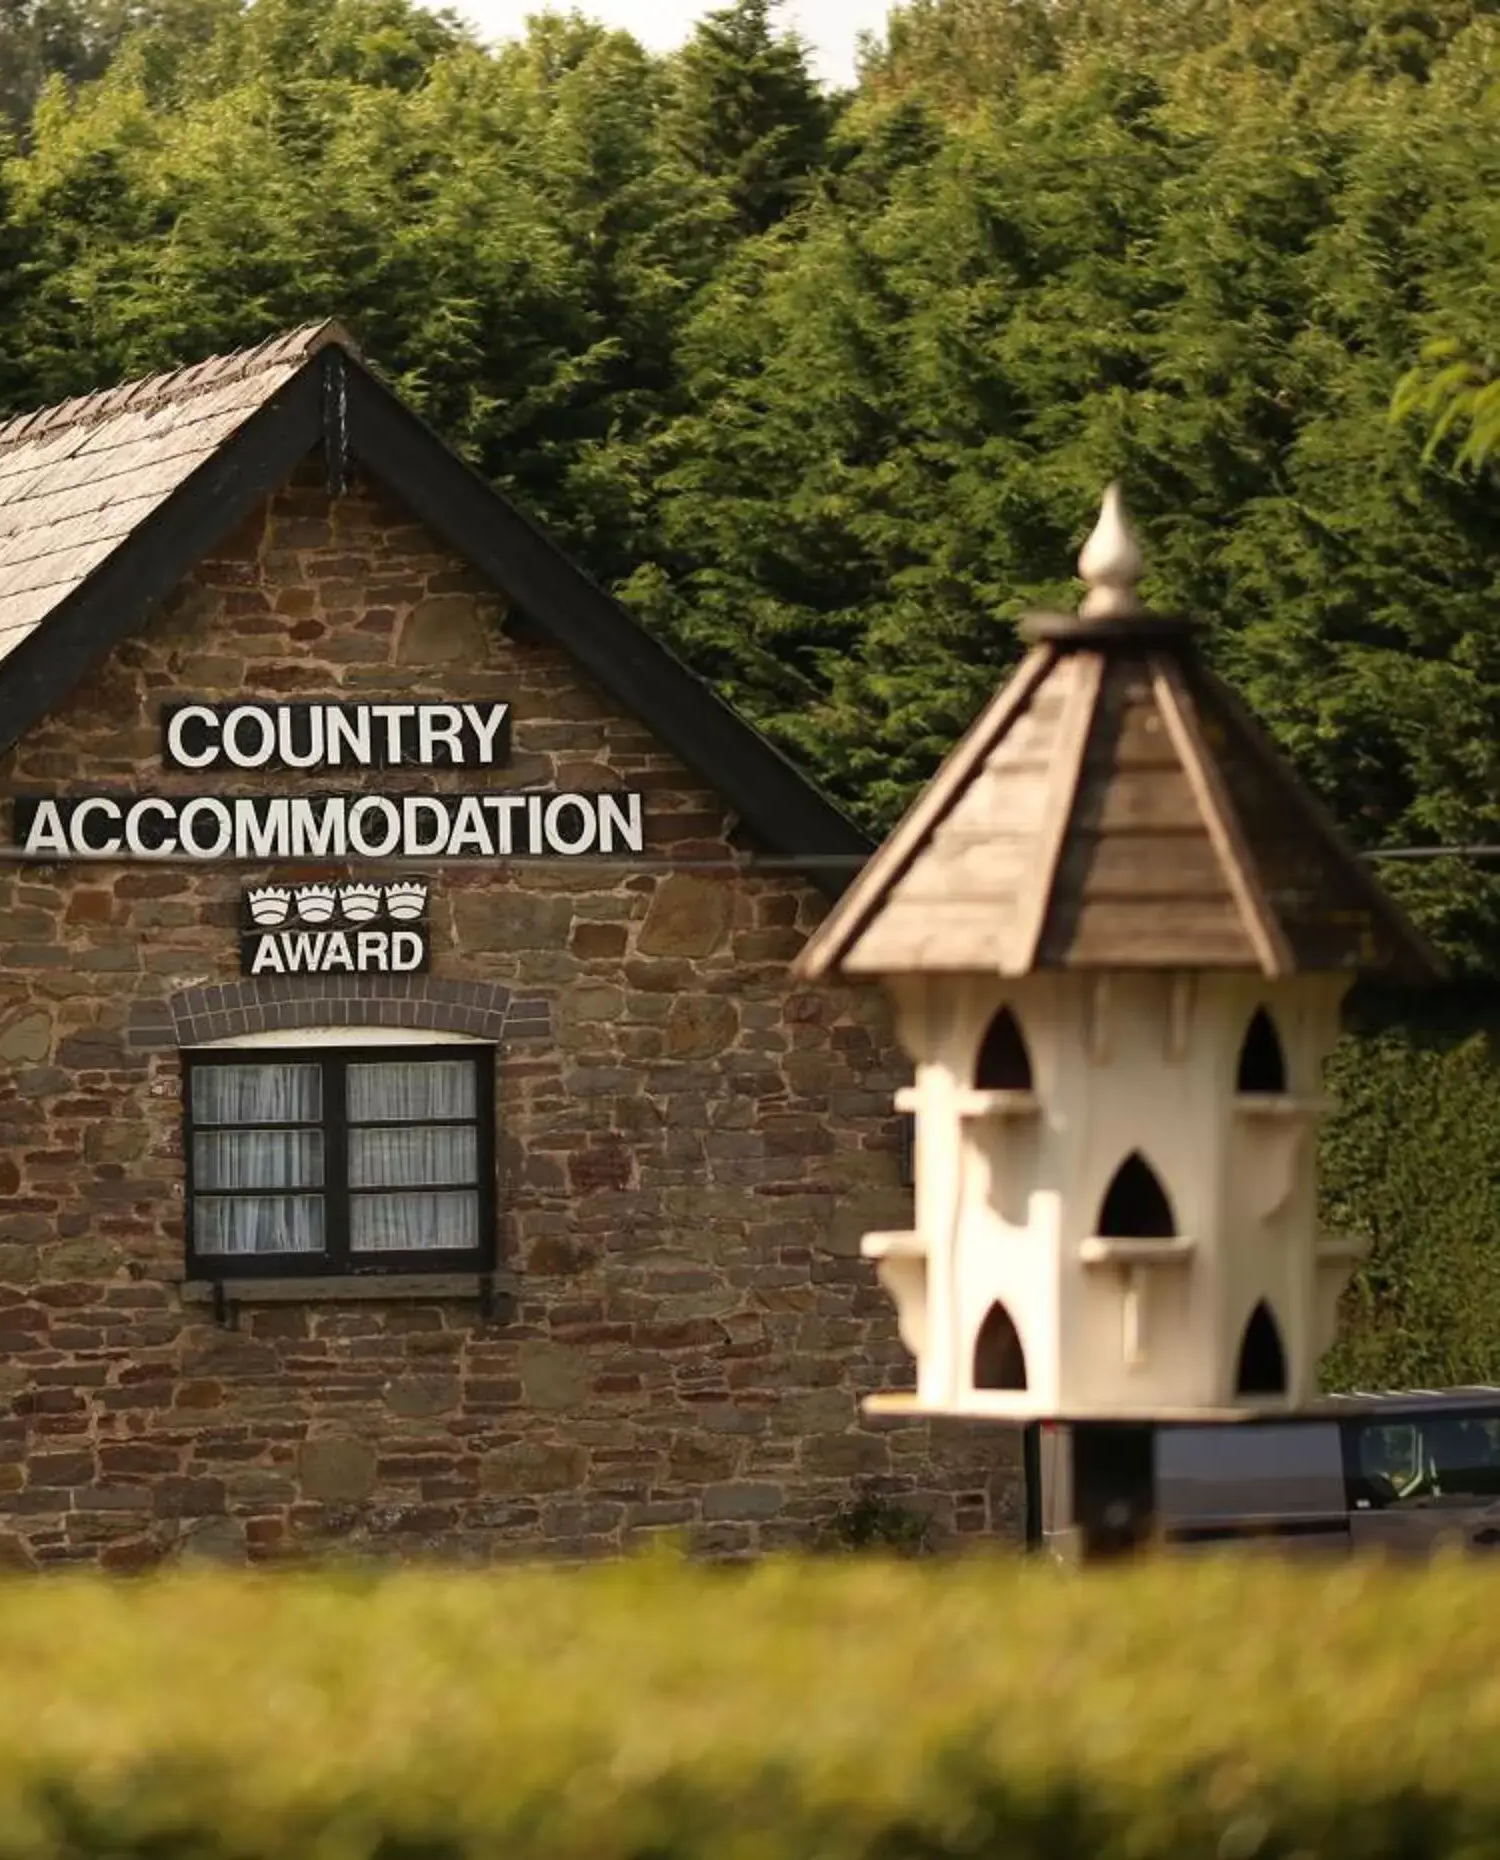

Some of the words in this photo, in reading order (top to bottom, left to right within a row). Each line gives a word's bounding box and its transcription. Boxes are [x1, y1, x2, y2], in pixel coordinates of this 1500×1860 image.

[167, 703, 508, 767] COUNTRY
[23, 793, 644, 858] ACCOMMODATION
[251, 931, 424, 974] AWARD
